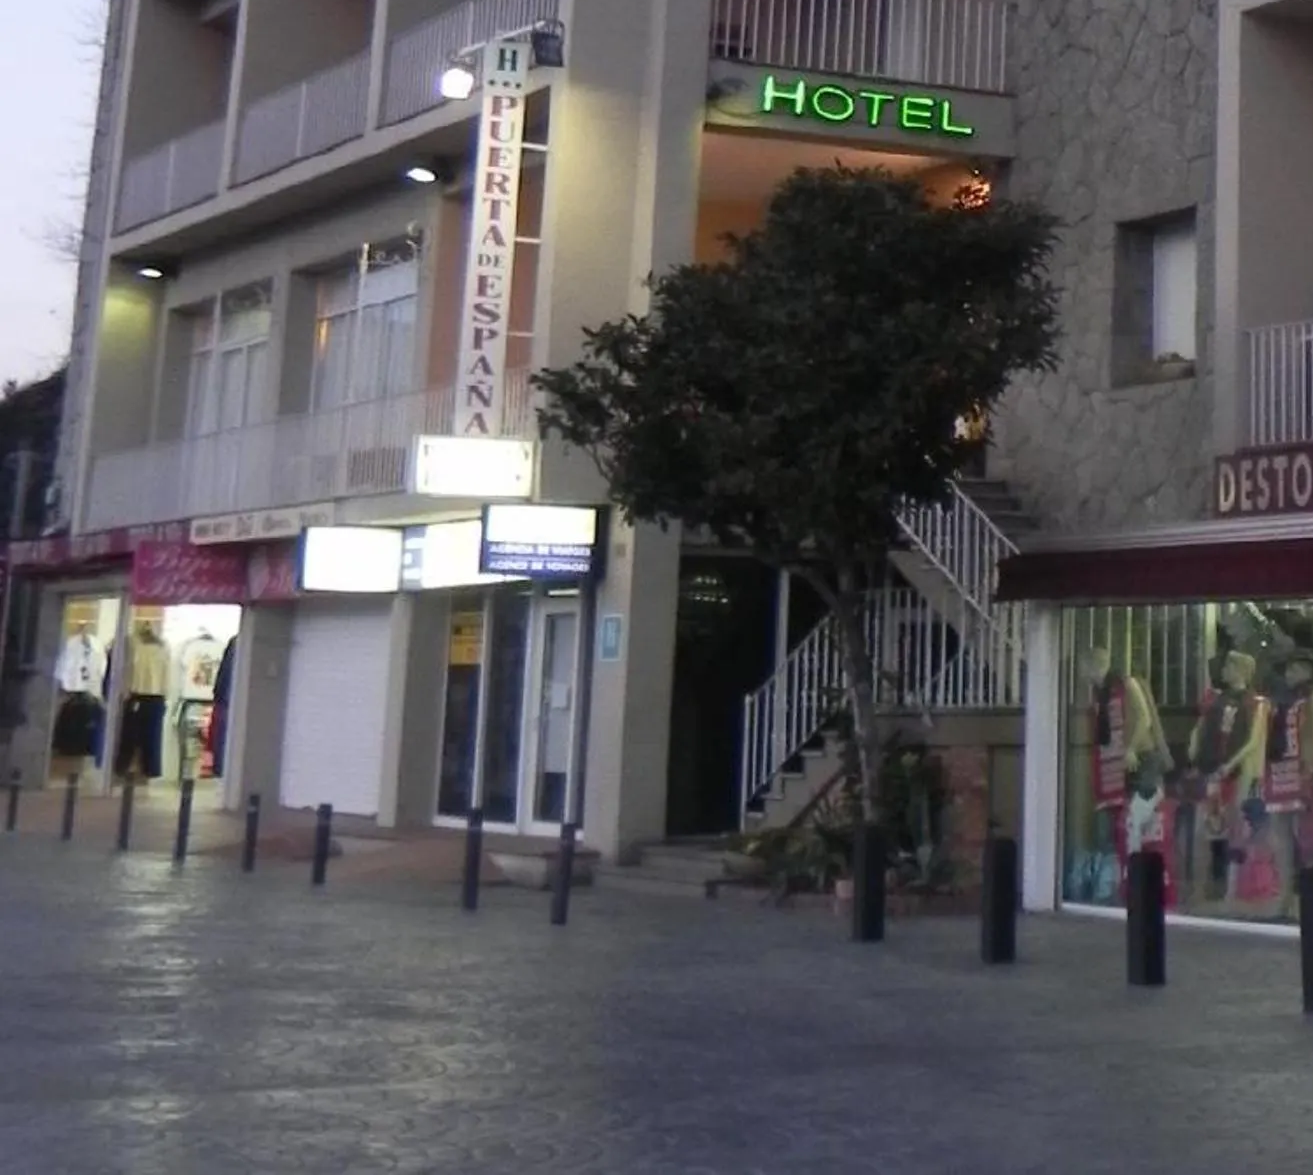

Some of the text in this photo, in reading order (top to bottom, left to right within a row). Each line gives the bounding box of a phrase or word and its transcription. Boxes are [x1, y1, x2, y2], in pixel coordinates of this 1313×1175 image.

[498, 49, 518, 73] H
[761, 75, 974, 136] HOTEL
[465, 95, 519, 434] PUERTA DE ESPAÑA
